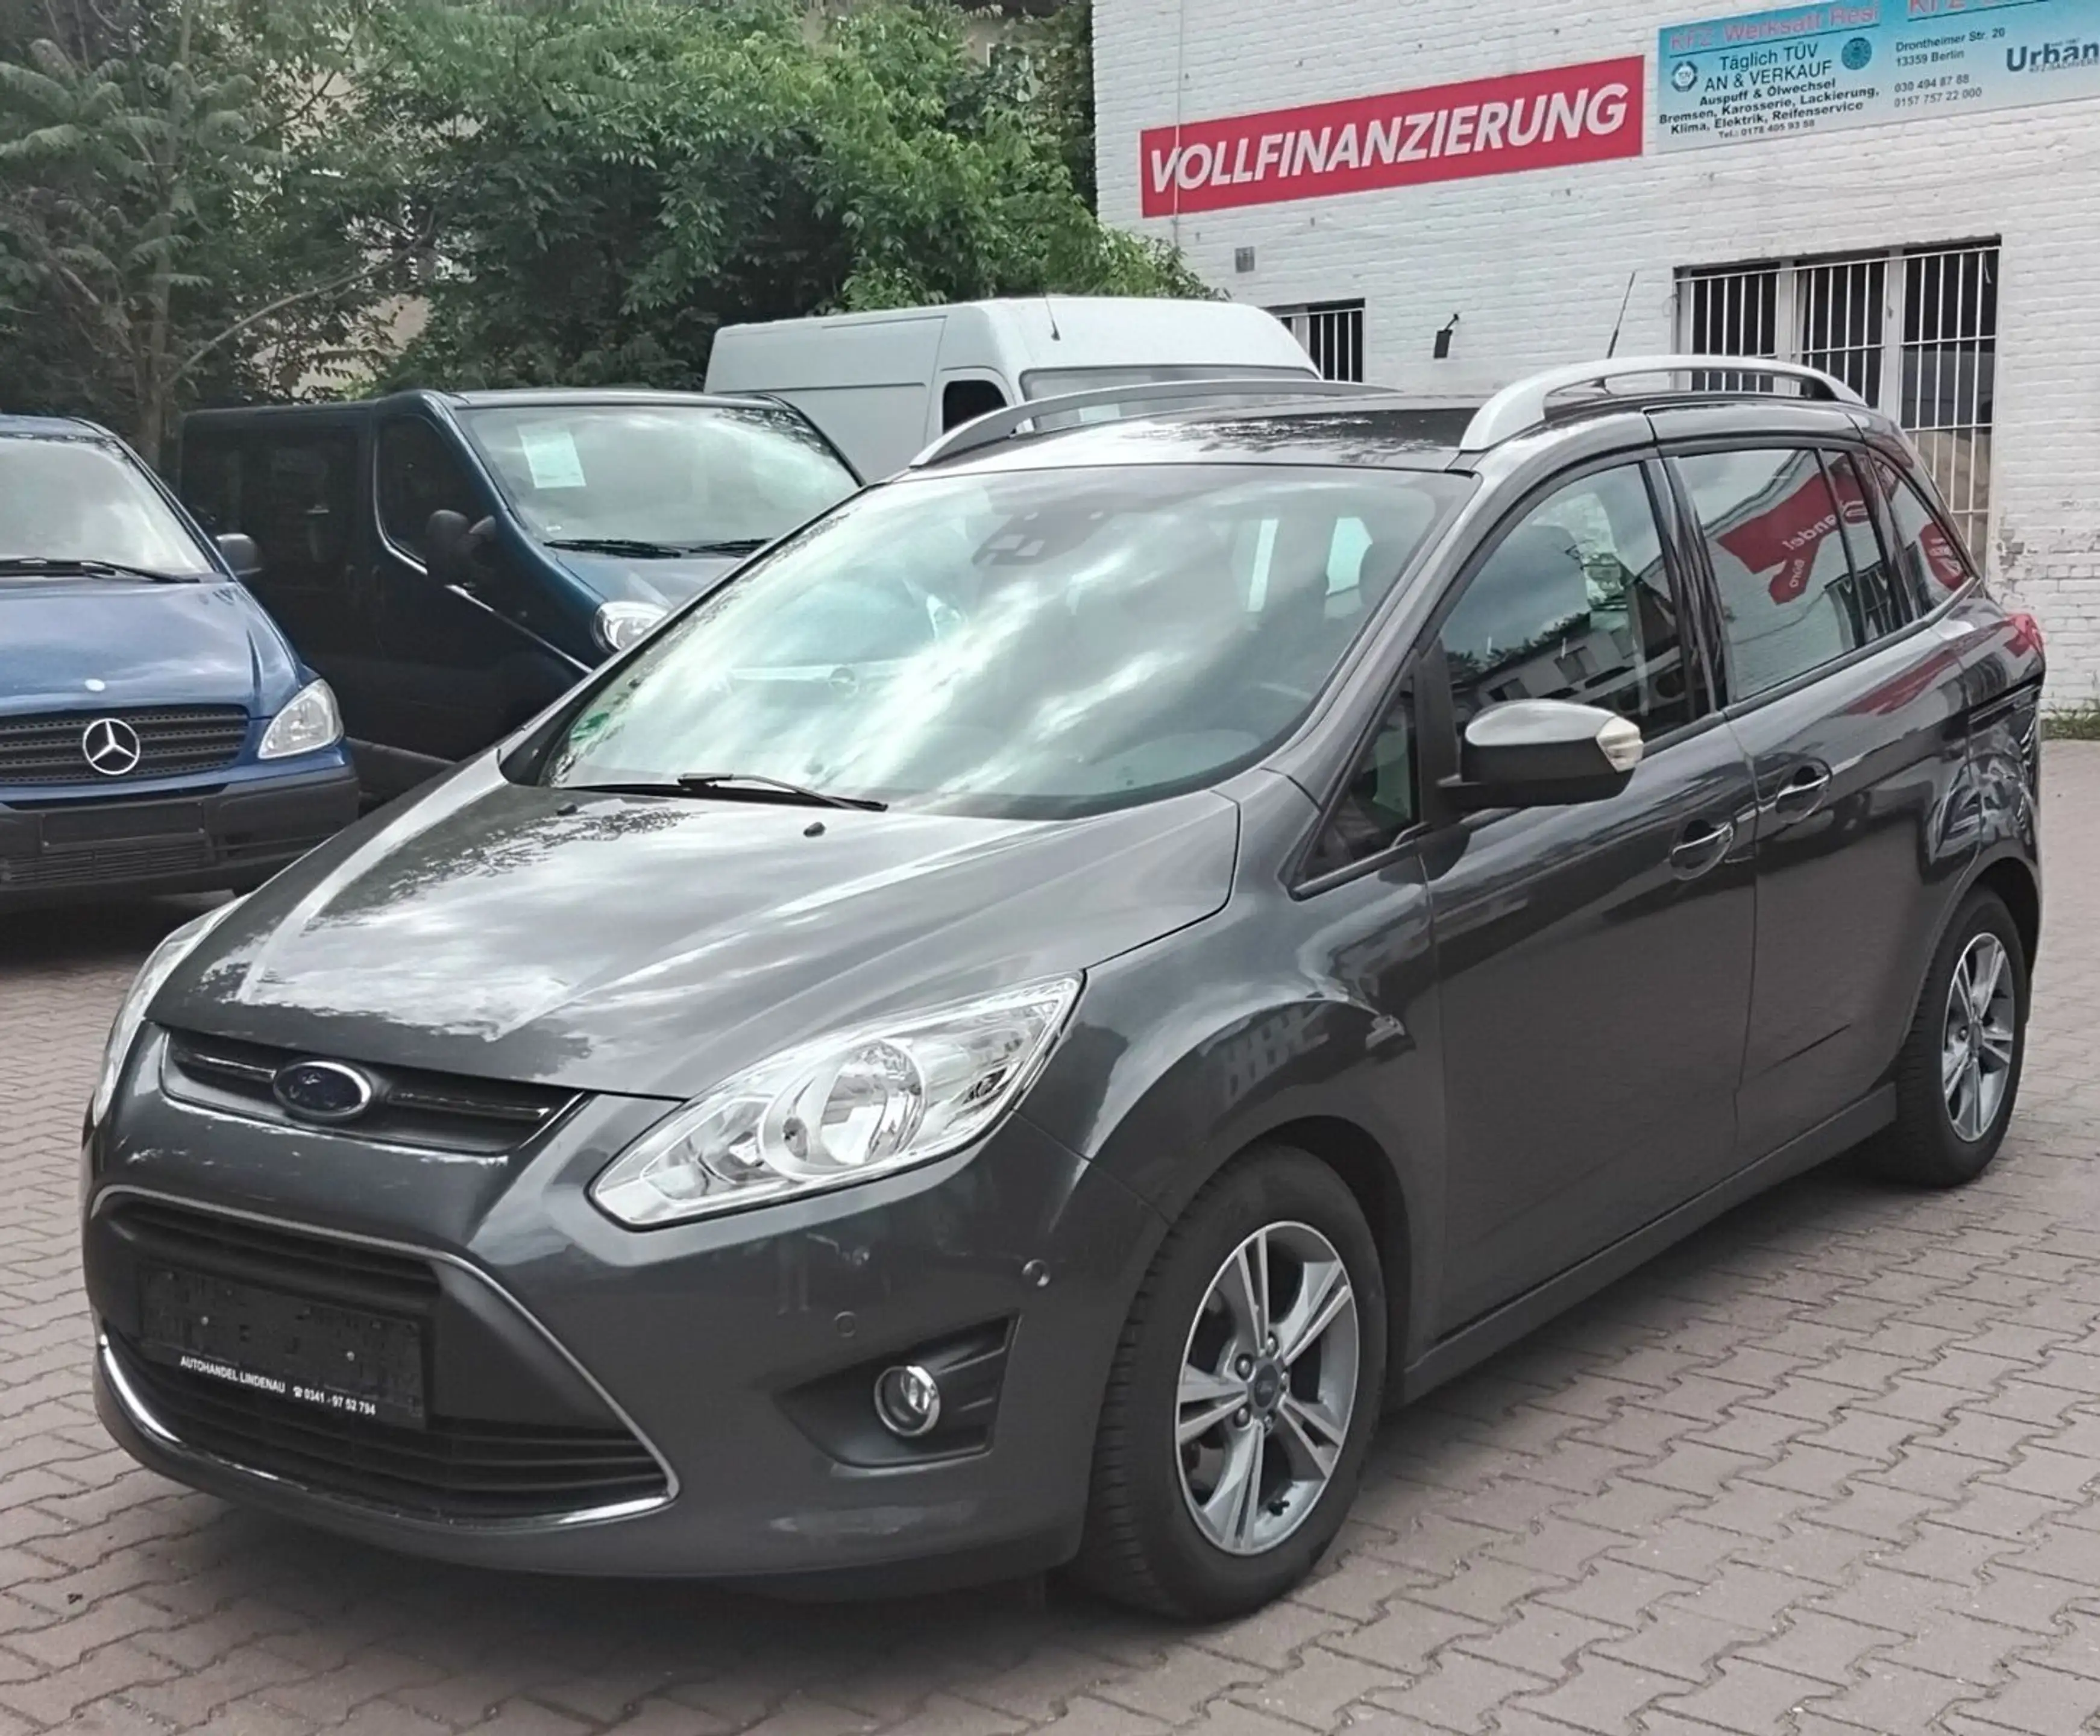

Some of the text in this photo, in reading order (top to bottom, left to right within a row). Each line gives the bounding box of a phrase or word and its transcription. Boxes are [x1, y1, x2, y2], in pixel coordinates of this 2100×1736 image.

[1896, 34, 1966, 52] Drontheimer
[1992, 27, 2005, 38] 20
[1720, 40, 1818, 72] Täglich TÜV
[1897, 49, 1964, 67] 13359 Berlin
[2007, 42, 2099, 72] Urban
[1704, 58, 1832, 92] AN & VERKAUF
[1700, 90, 1748, 106] Auspuff
[1753, 88, 1762, 99] &
[1800, 87, 1879, 105] Lackierung,
[1923, 92, 1943, 104] 757
[1946, 90, 1958, 101] 22
[1773, 101, 1864, 121] Reifenservice
[1151, 83, 1628, 192] VOLLFINANZIERUNG
[180, 1355, 239, 1382] AUTOHANDEL
[240, 1370, 286, 1394] LINDENAU
[304, 1388, 325, 1403] 0341
[332, 1394, 344, 1407] 97
